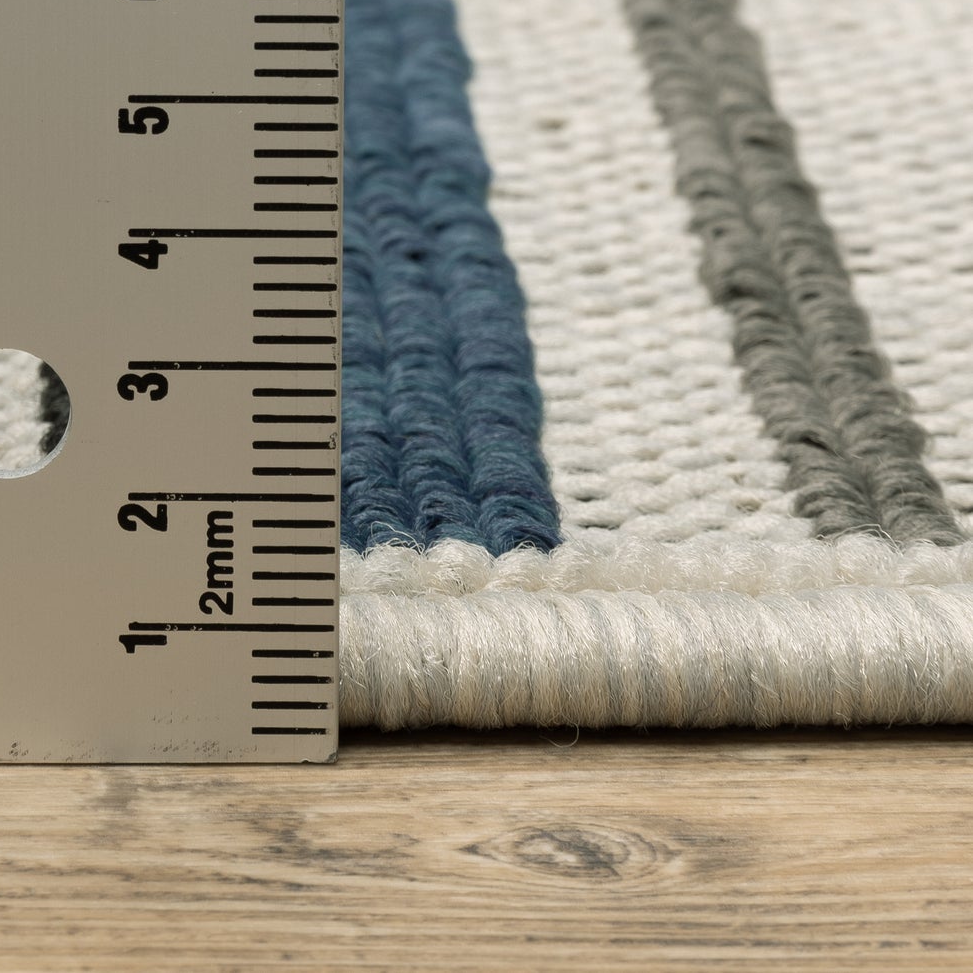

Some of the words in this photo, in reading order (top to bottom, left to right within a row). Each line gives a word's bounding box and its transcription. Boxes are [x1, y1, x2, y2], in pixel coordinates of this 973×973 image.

[118, 106, 169, 134] 5
[118, 239, 168, 269] 4
[117, 373, 169, 401] 3
[118, 504, 167, 532] 2
[199, 511, 234, 615] 2mm
[119, 634, 167, 654] 1
